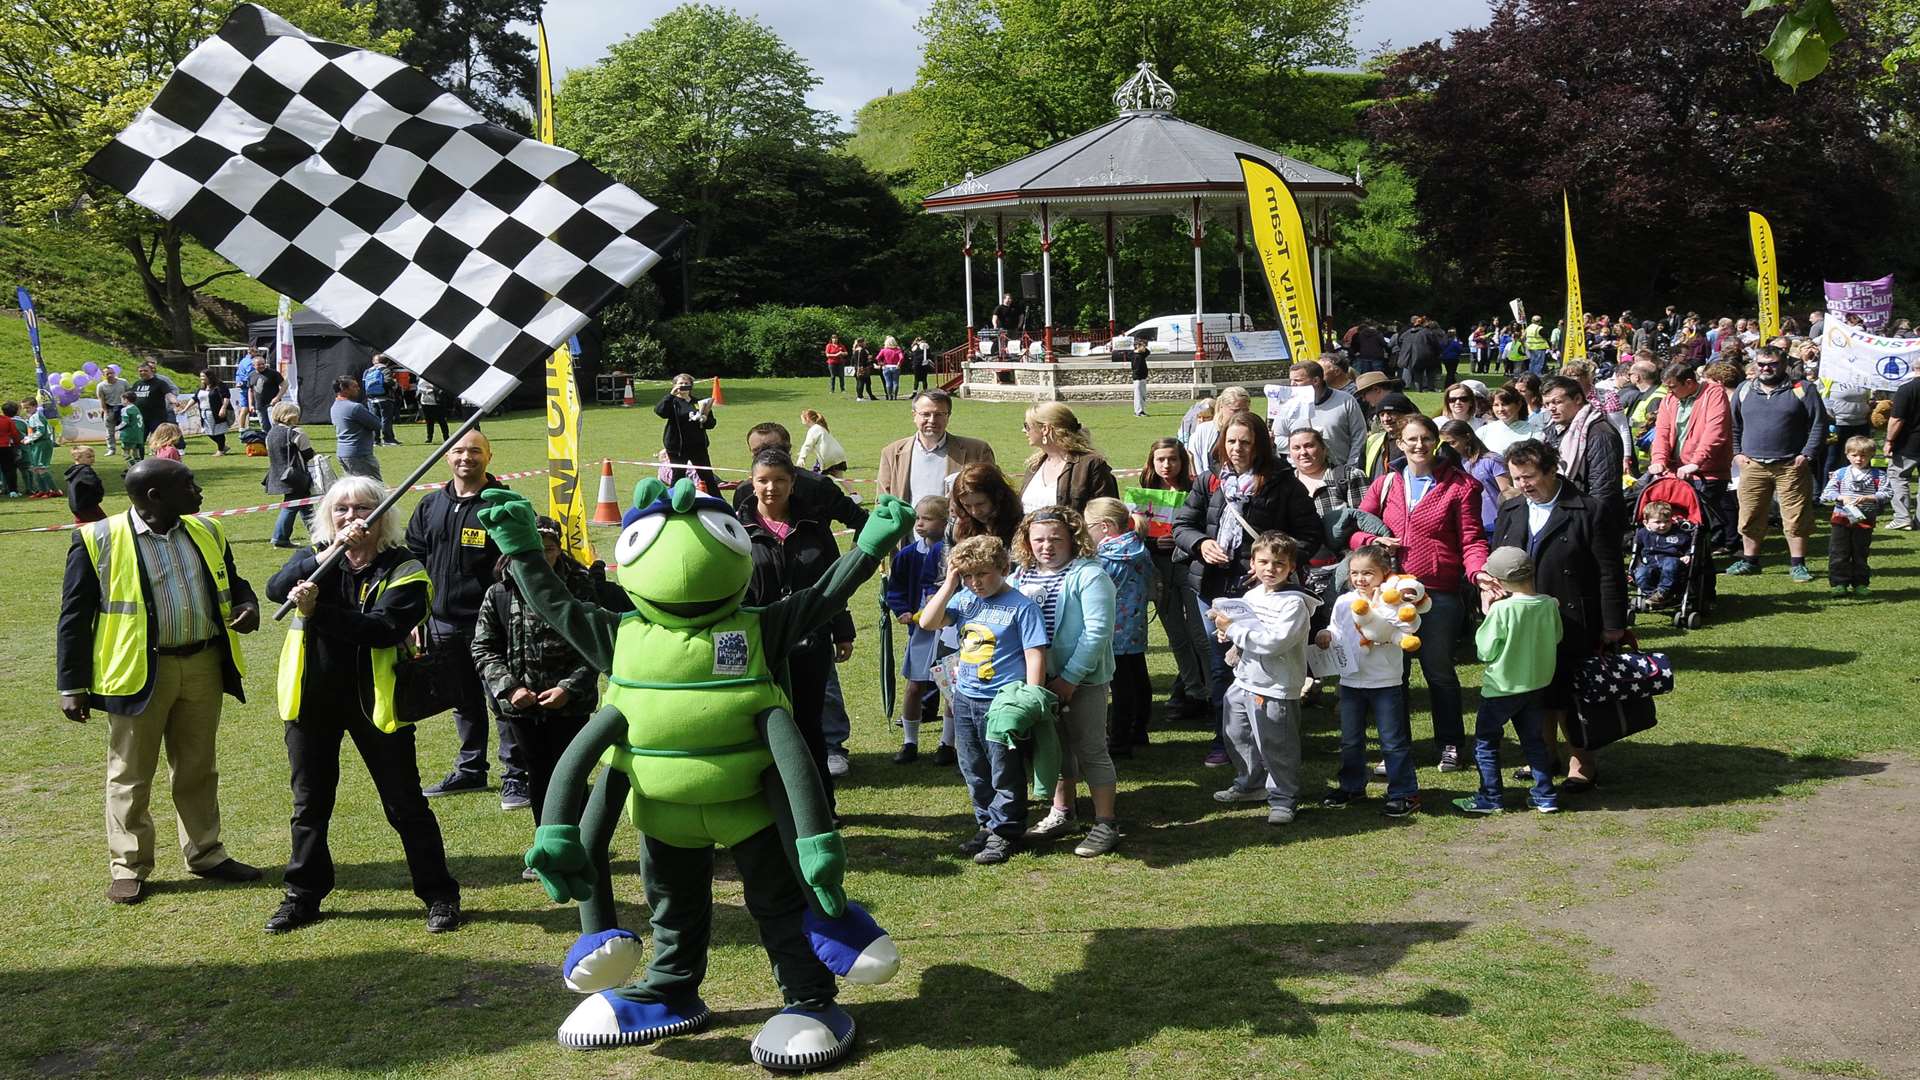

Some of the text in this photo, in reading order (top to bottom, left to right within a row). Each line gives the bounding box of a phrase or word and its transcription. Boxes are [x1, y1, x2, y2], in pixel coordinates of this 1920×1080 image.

[1843, 284, 1873, 298] The
[1825, 293, 1894, 311] anterbur
[136, 414, 144, 428] 3
[463, 529, 479, 537] KM
